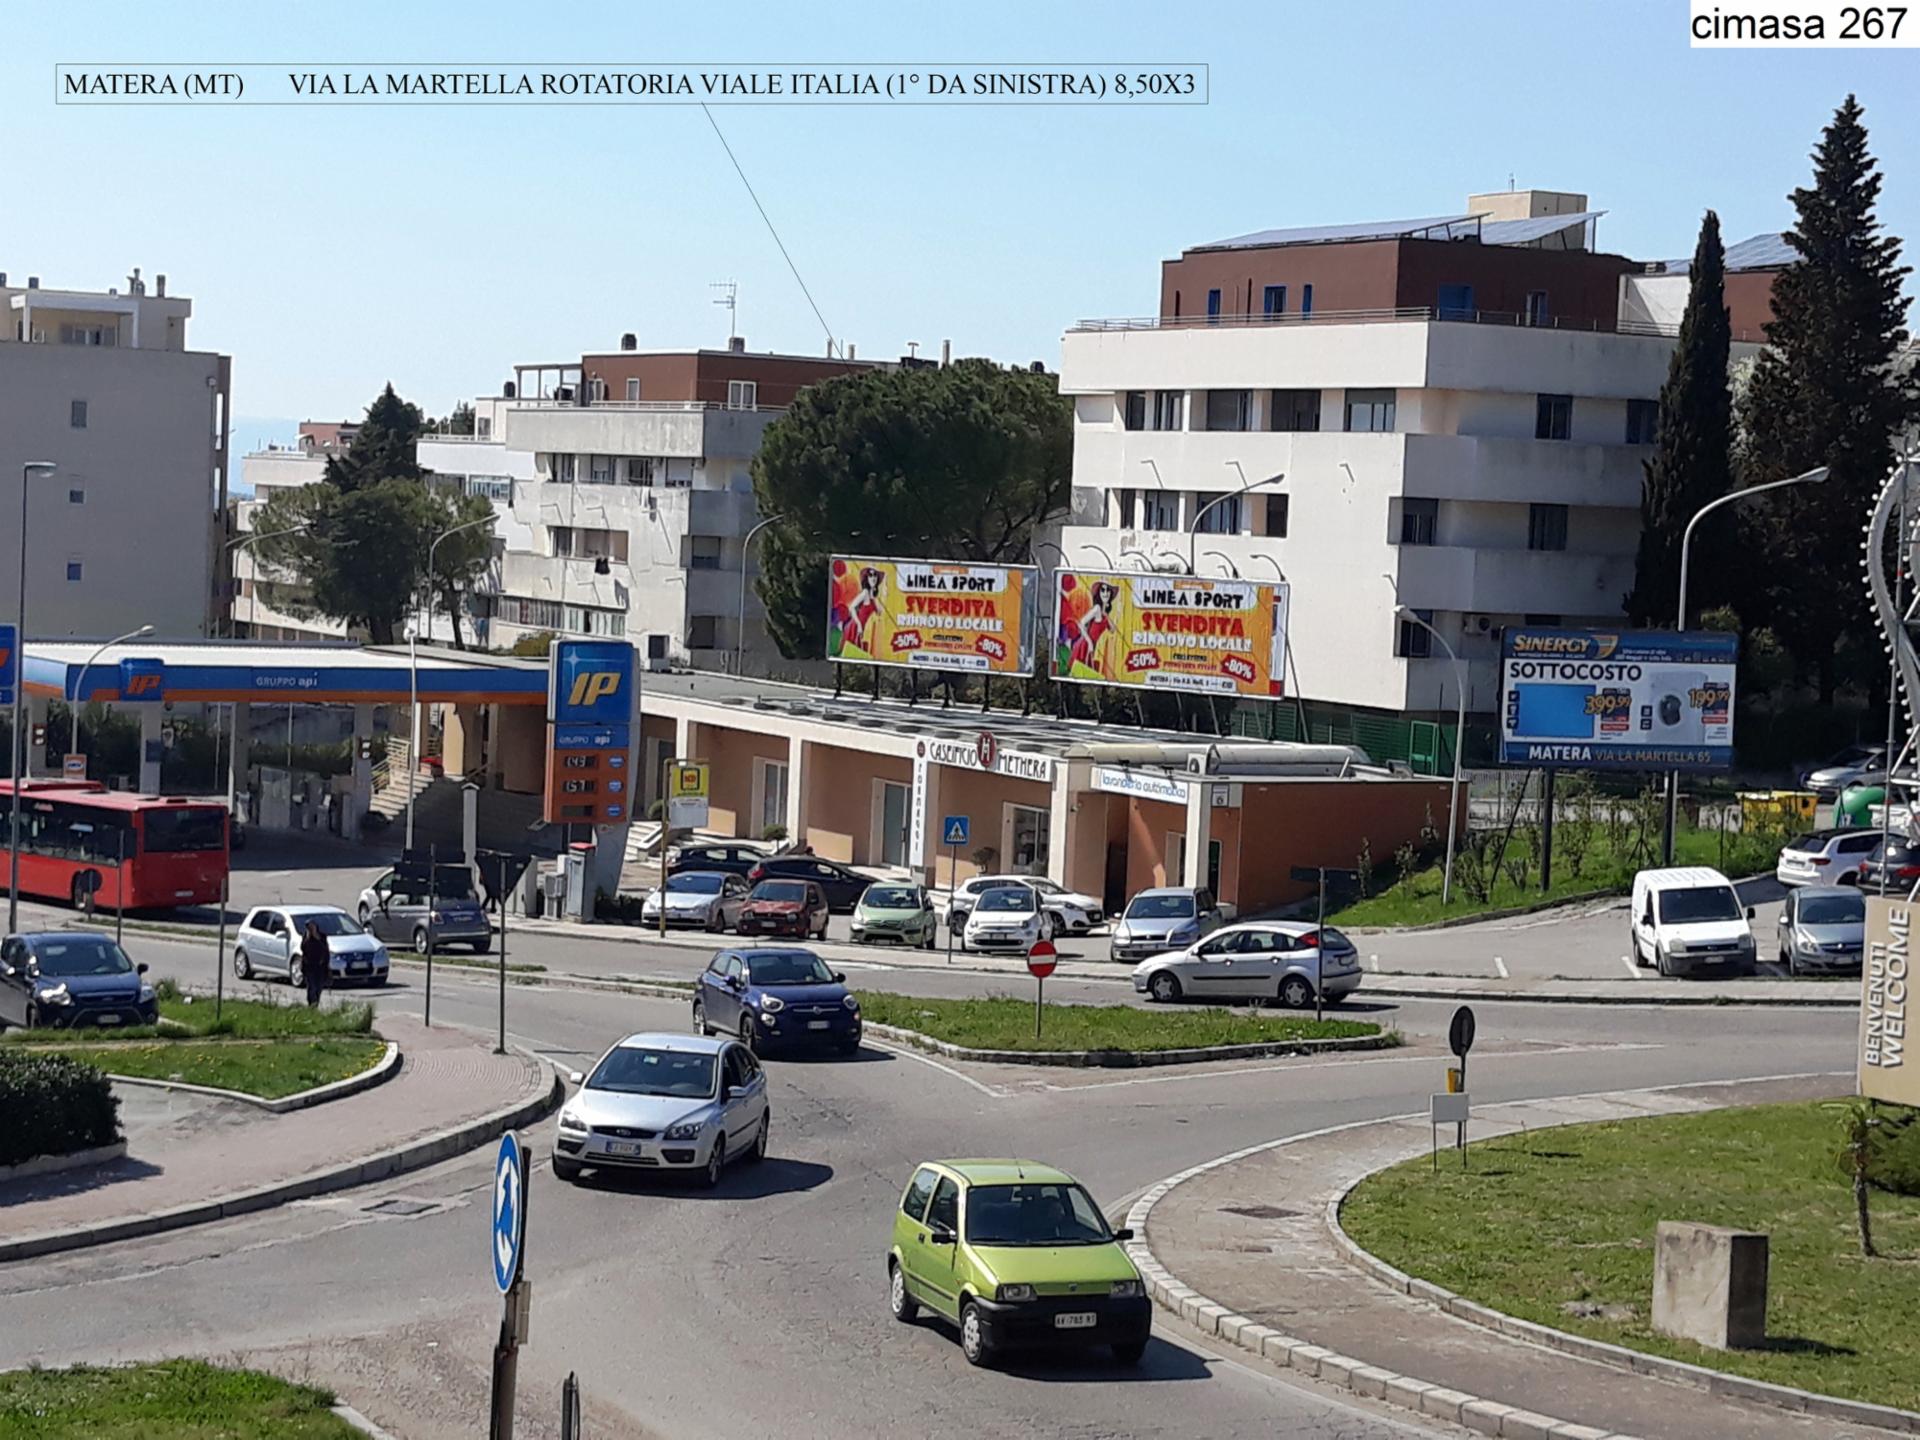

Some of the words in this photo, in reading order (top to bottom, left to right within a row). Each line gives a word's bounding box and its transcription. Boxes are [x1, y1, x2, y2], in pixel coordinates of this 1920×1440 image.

[907, 574, 947, 590] LINEA
[951, 576, 996, 592] SPORT
[906, 596, 996, 618] SVENDITA
[1143, 589, 1188, 606] LINEA
[1194, 591, 1243, 609] SPORT
[1141, 611, 1244, 638] SVENDITA
[1513, 634, 1592, 653] SINERGY
[256, 676, 297, 688] GRUPPO
[298, 673, 319, 688] api
[1510, 661, 1643, 682] SOTTOCOSTO
[126, 674, 162, 695] IP
[567, 672, 621, 706] IP
[930, 742, 978, 767] CASEIFICIO
[1000, 753, 1047, 780] METHERA
[1528, 745, 1592, 761] MATERA
[1880, 906, 1911, 1068] WELCOME
[1865, 941, 1887, 1066] BENVENUTI
